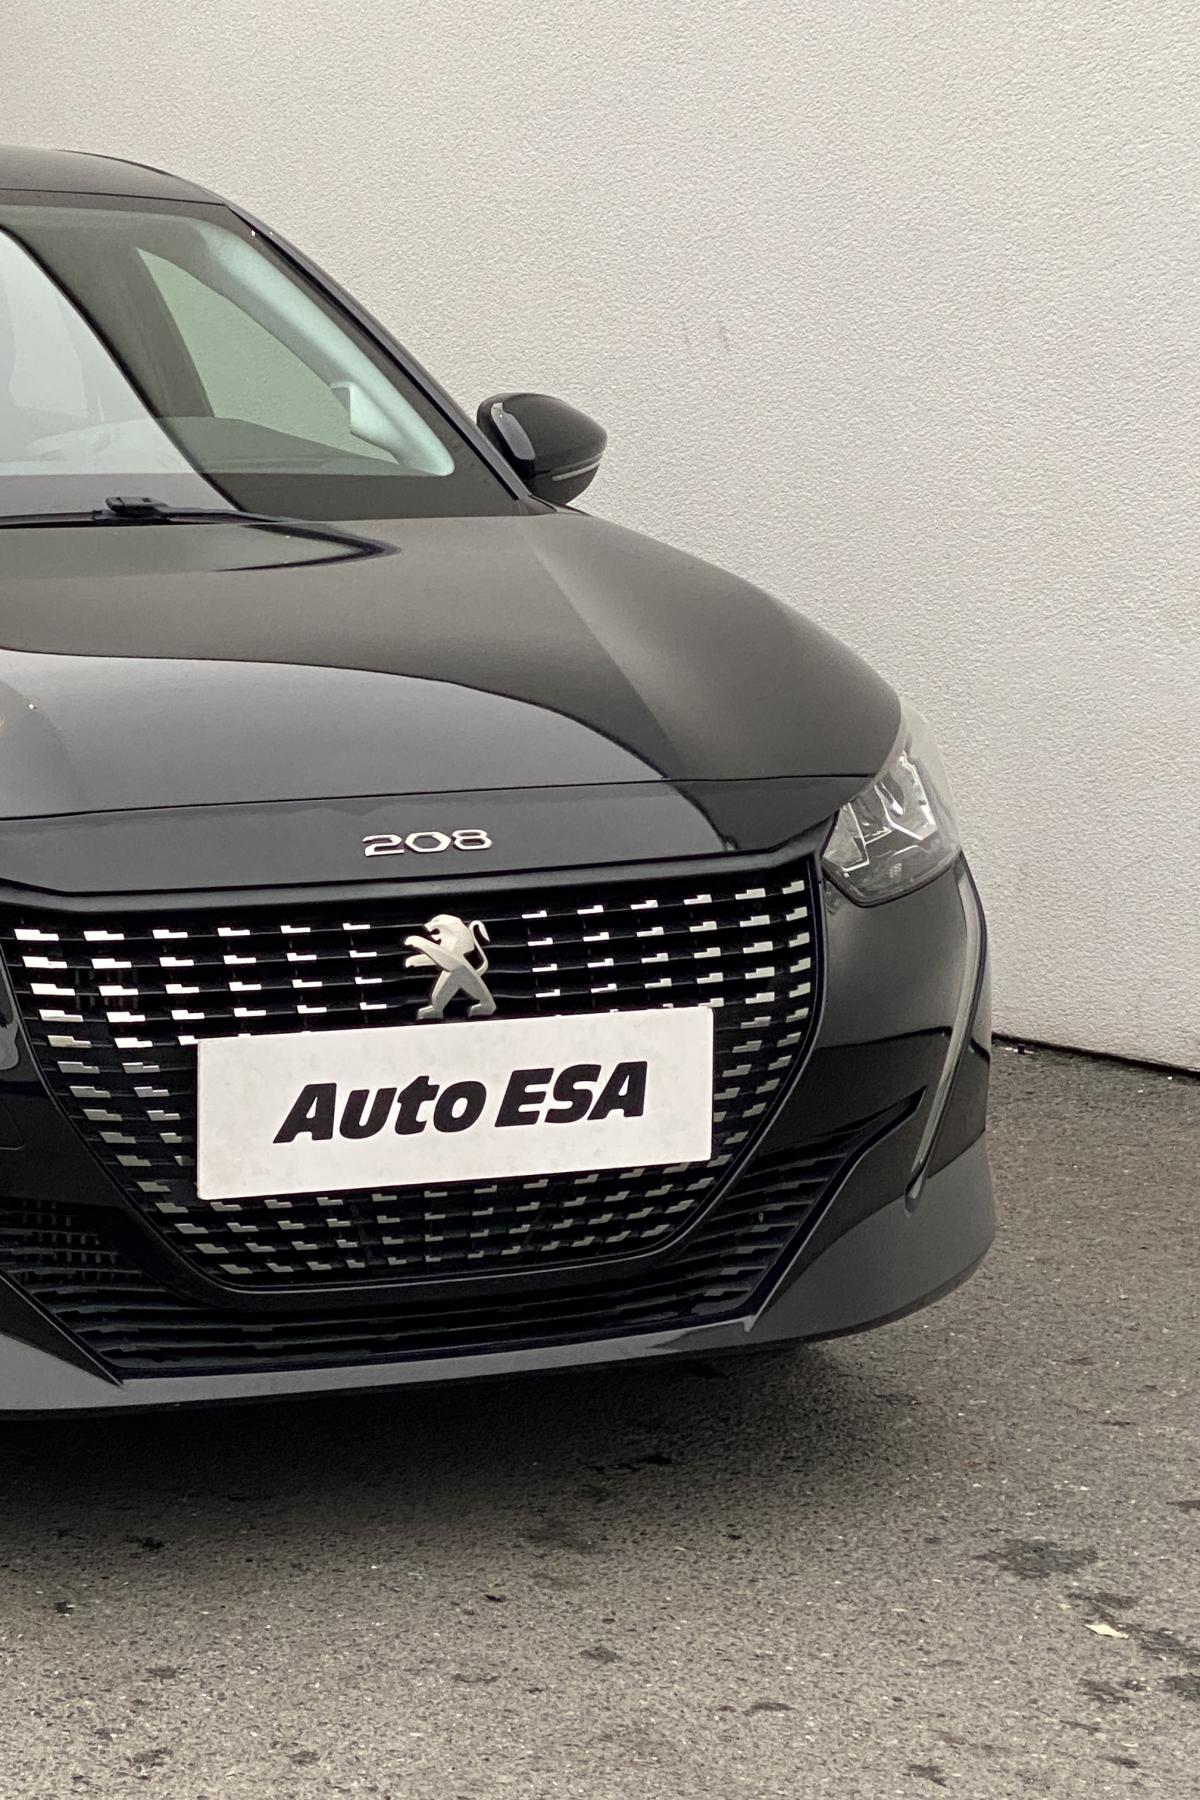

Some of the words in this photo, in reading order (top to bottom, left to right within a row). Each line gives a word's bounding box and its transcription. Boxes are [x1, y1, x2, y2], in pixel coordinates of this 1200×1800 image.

[362, 829, 493, 857] 208
[272, 1075, 487, 1144] Auto
[495, 1060, 648, 1127] ESA
